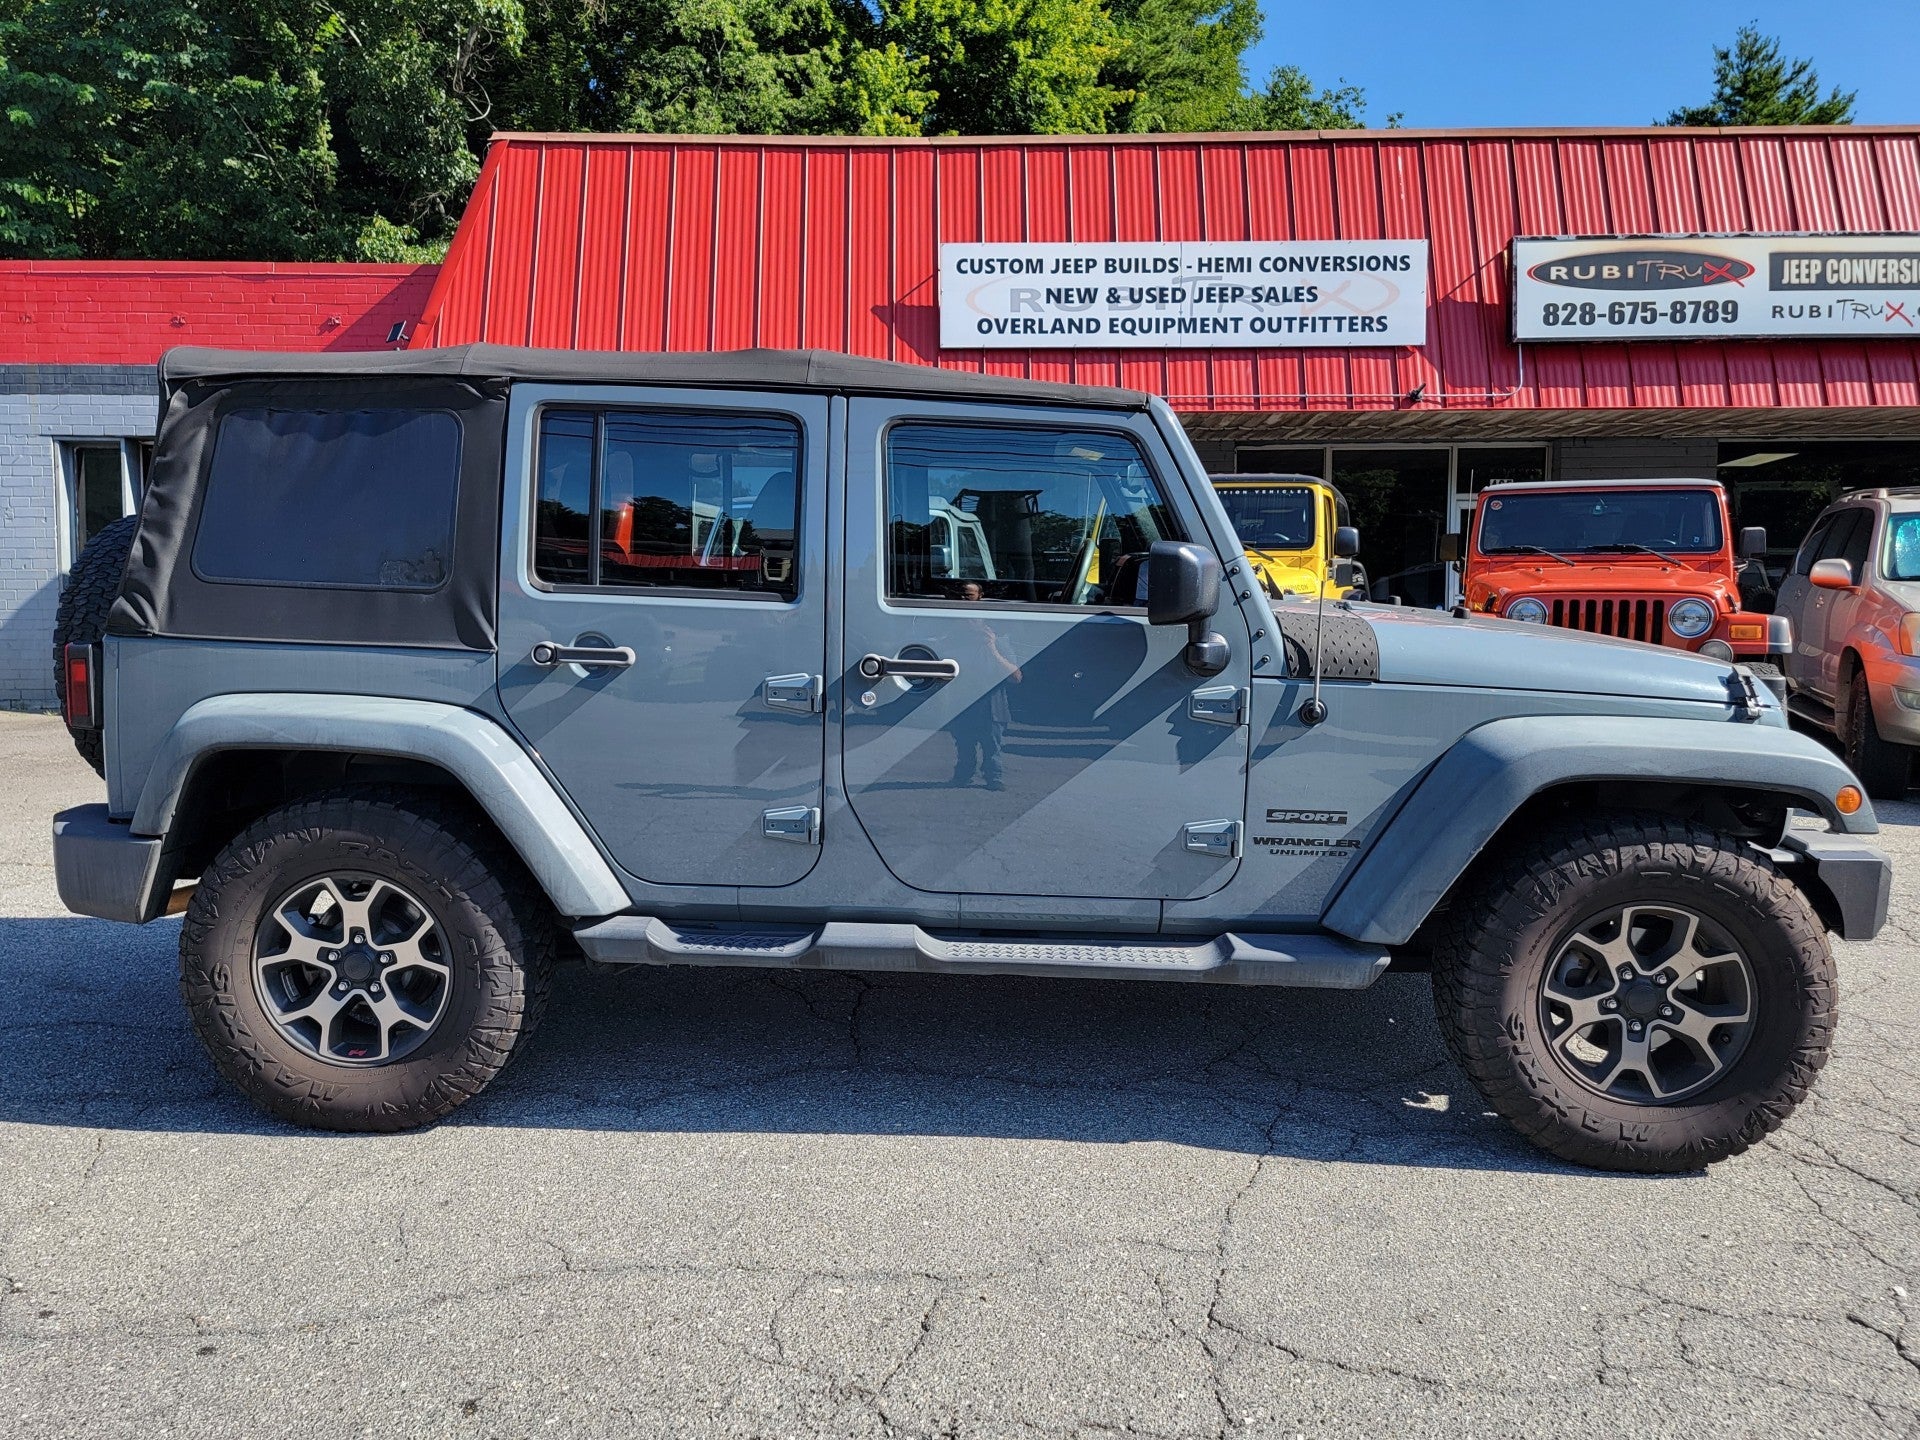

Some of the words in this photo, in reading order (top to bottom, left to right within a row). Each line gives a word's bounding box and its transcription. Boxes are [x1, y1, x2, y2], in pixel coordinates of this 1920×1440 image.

[956, 258, 1044, 274] CUSTOM
[1050, 258, 1098, 274] JEEP
[1104, 257, 1179, 274] BUILDS
[1197, 257, 1251, 273] HEMI
[1259, 255, 1411, 273] CONVERSIONS
[1549, 259, 1746, 288] RUBITRUX
[1781, 259, 1822, 285] JEEP
[1826, 258, 1920, 285] CONVERSI
[1046, 287, 1098, 304] NEW
[1105, 287, 1121, 304] &
[1129, 287, 1186, 304] USED
[1193, 287, 1244, 303] JEEP
[1251, 286, 1318, 303] SALES
[1542, 299, 1739, 327] 828-675-8789
[977, 317, 1101, 335] OVERLAND
[1108, 316, 1243, 336] EQUIPMENT
[1249, 315, 1388, 334] OUTFITTERS
[1270, 811, 1341, 823] SPORT
[1252, 836, 1362, 850] WRANGLER
[1269, 848, 1348, 857] UNLIMITED
